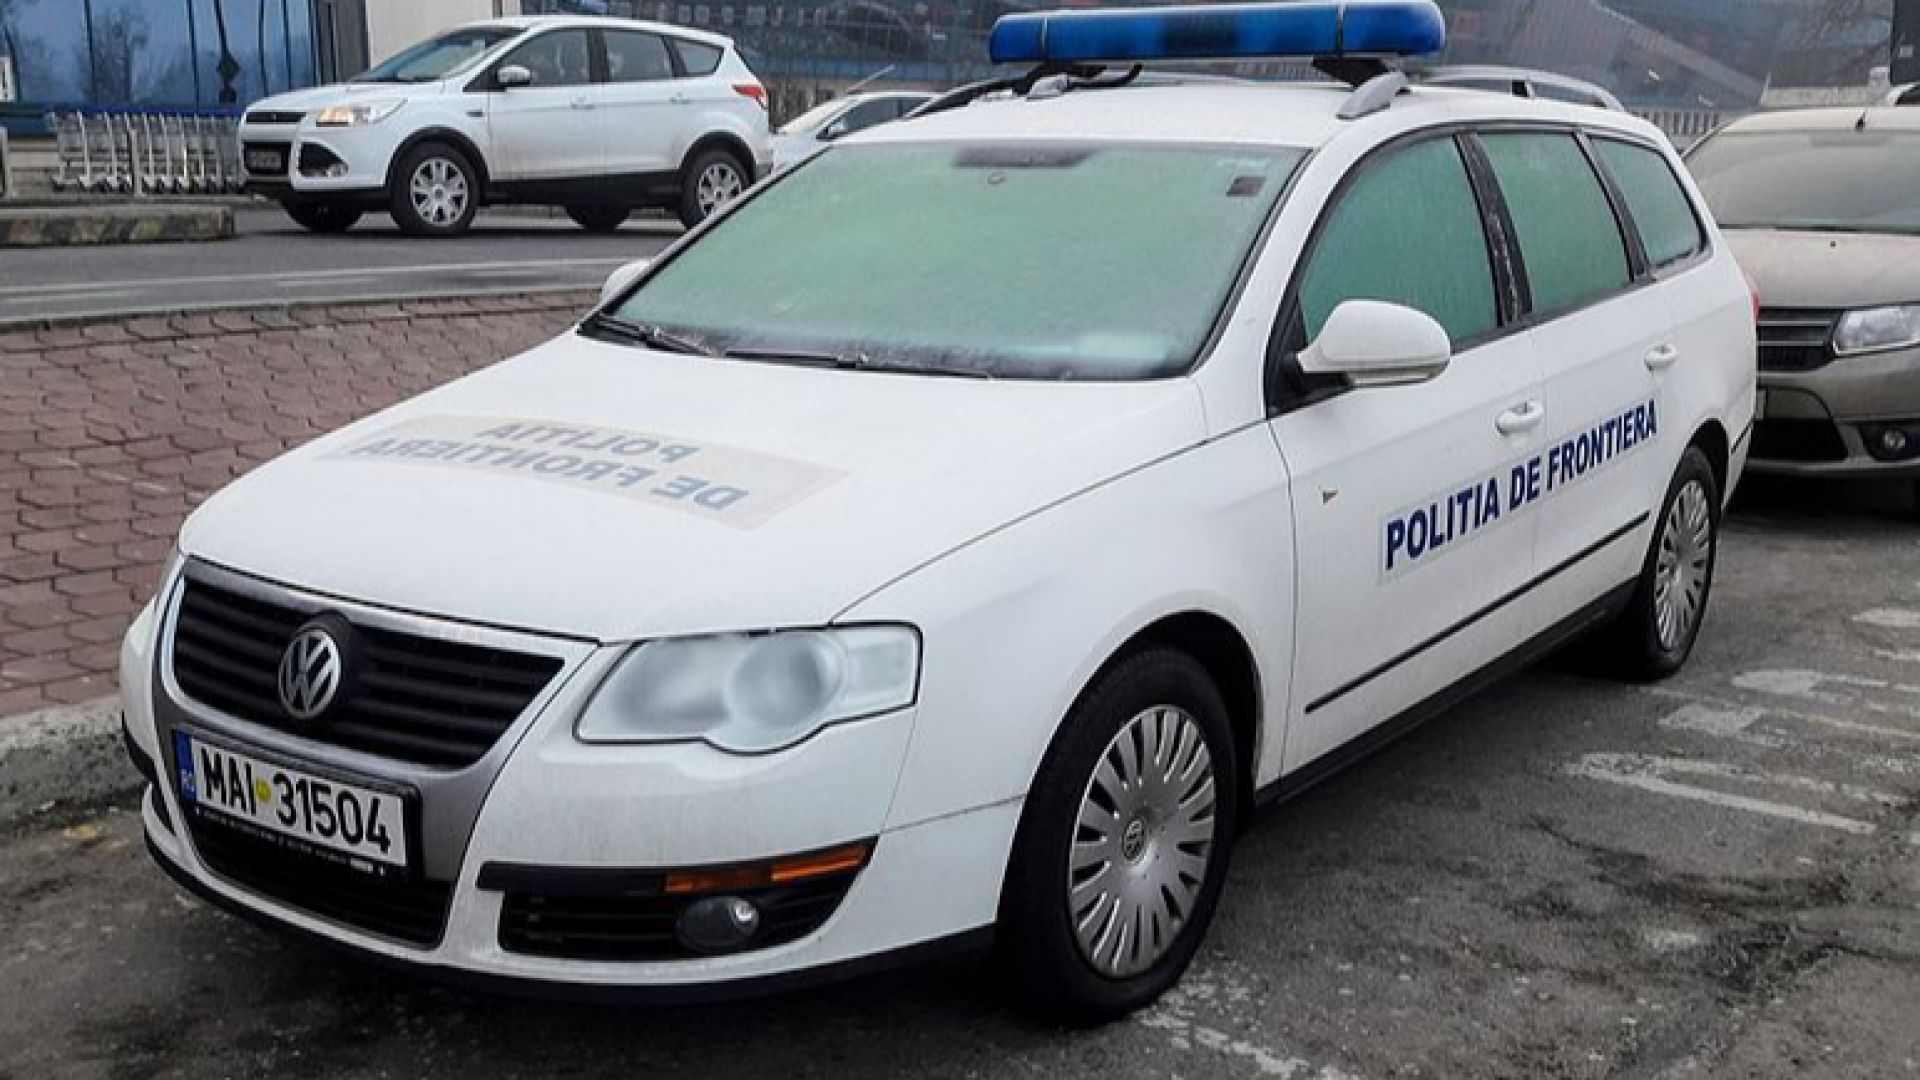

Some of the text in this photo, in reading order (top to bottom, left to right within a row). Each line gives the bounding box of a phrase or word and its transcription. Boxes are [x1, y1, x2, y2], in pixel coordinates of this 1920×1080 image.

[1386, 398, 1657, 570] POLITIA DE FRONTIERA
[201, 747, 256, 815] MAI
[273, 771, 391, 853] 31504
